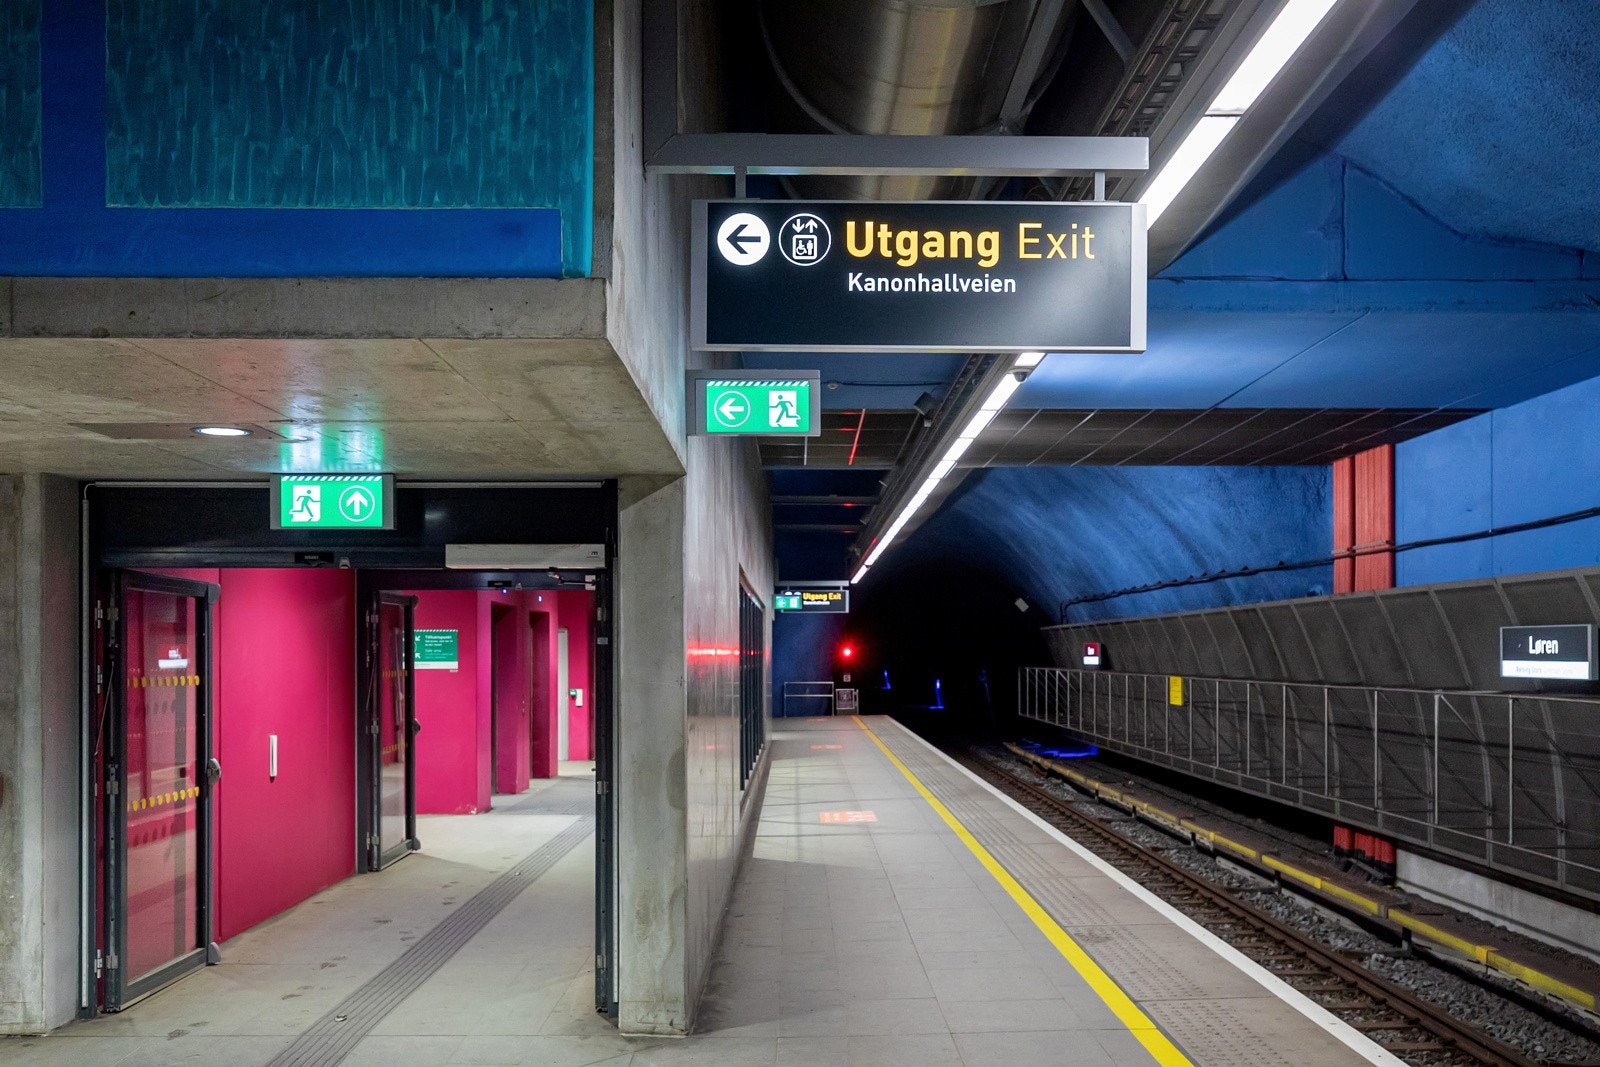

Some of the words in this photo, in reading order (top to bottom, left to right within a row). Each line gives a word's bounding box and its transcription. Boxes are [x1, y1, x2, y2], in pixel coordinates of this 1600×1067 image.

[846, 220, 1000, 268] Utgang
[1018, 222, 1096, 260] Exit
[848, 271, 1017, 293] Kanonhallveien
[803, 592, 828, 601] Utgang
[828, 592, 842, 600] Exit
[1528, 636, 1558, 655] Løren
